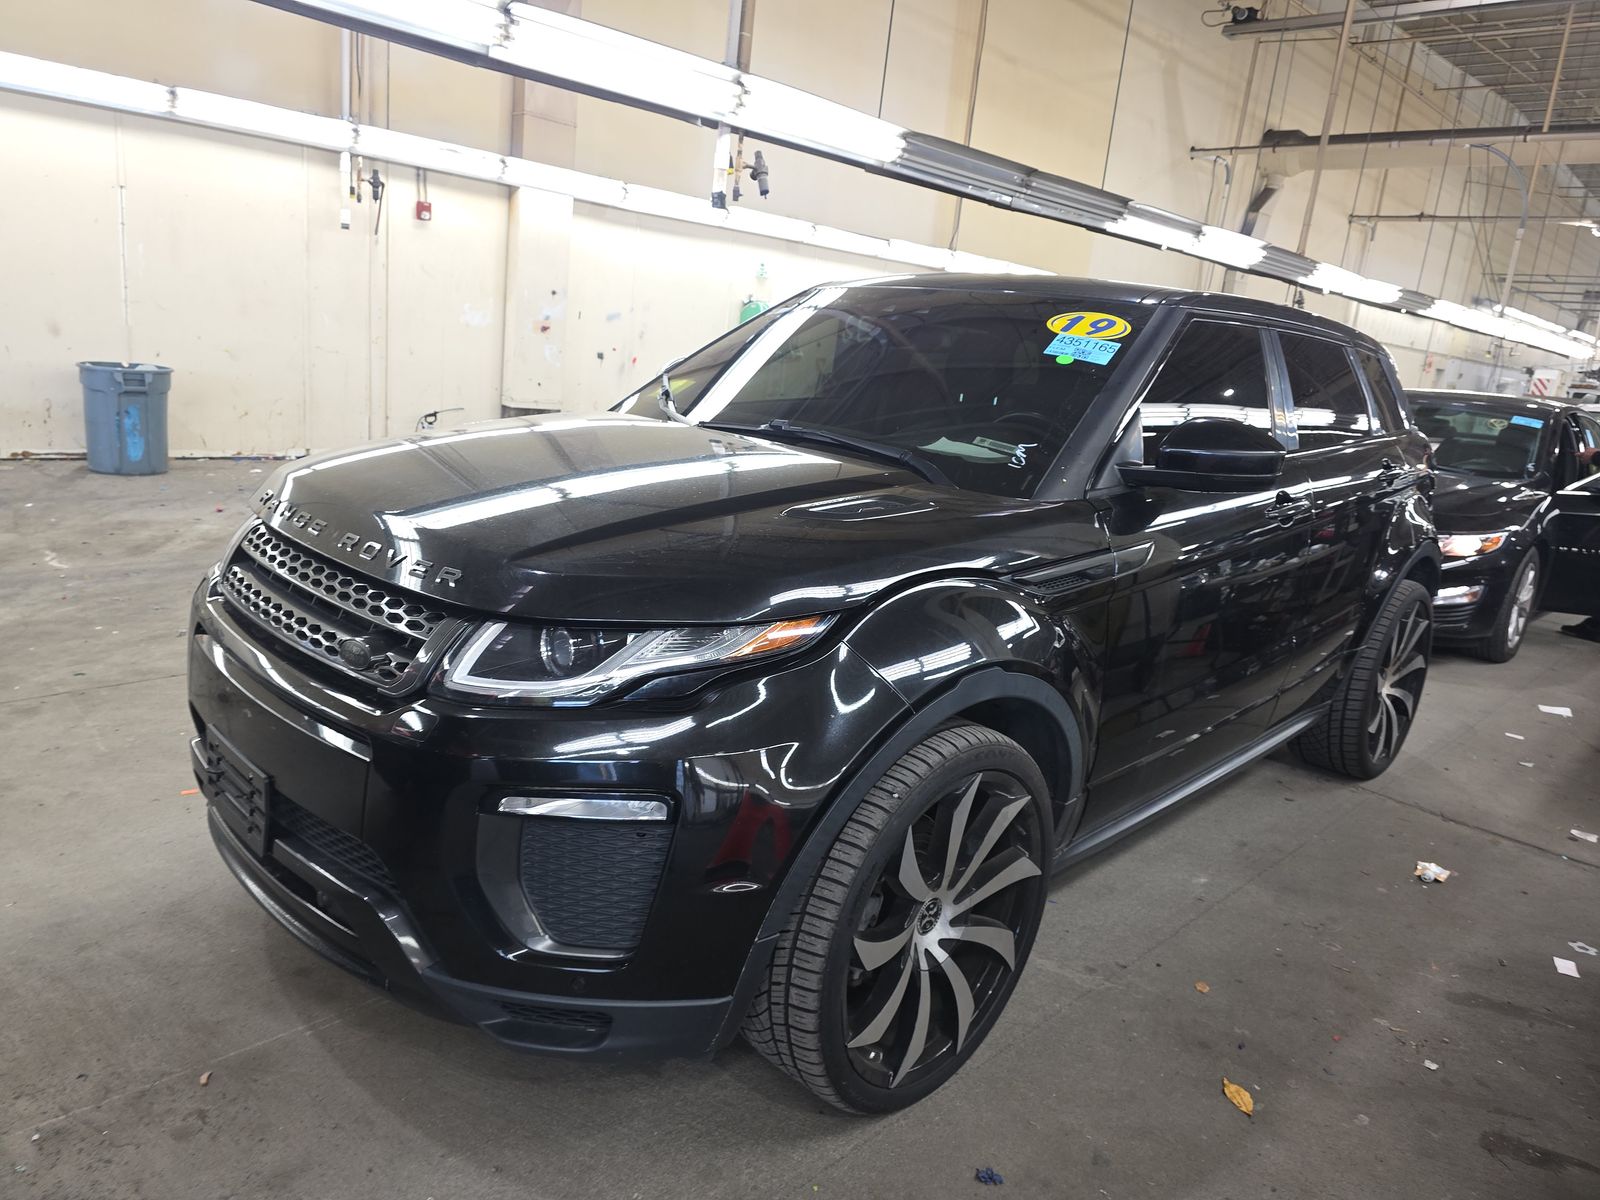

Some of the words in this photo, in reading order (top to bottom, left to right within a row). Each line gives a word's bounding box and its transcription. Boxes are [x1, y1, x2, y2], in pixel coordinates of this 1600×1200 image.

[1060, 315, 1117, 336] 19
[1056, 336, 1116, 354] 4351165
[260, 489, 328, 536] RANGE
[337, 532, 462, 588] ROVER
